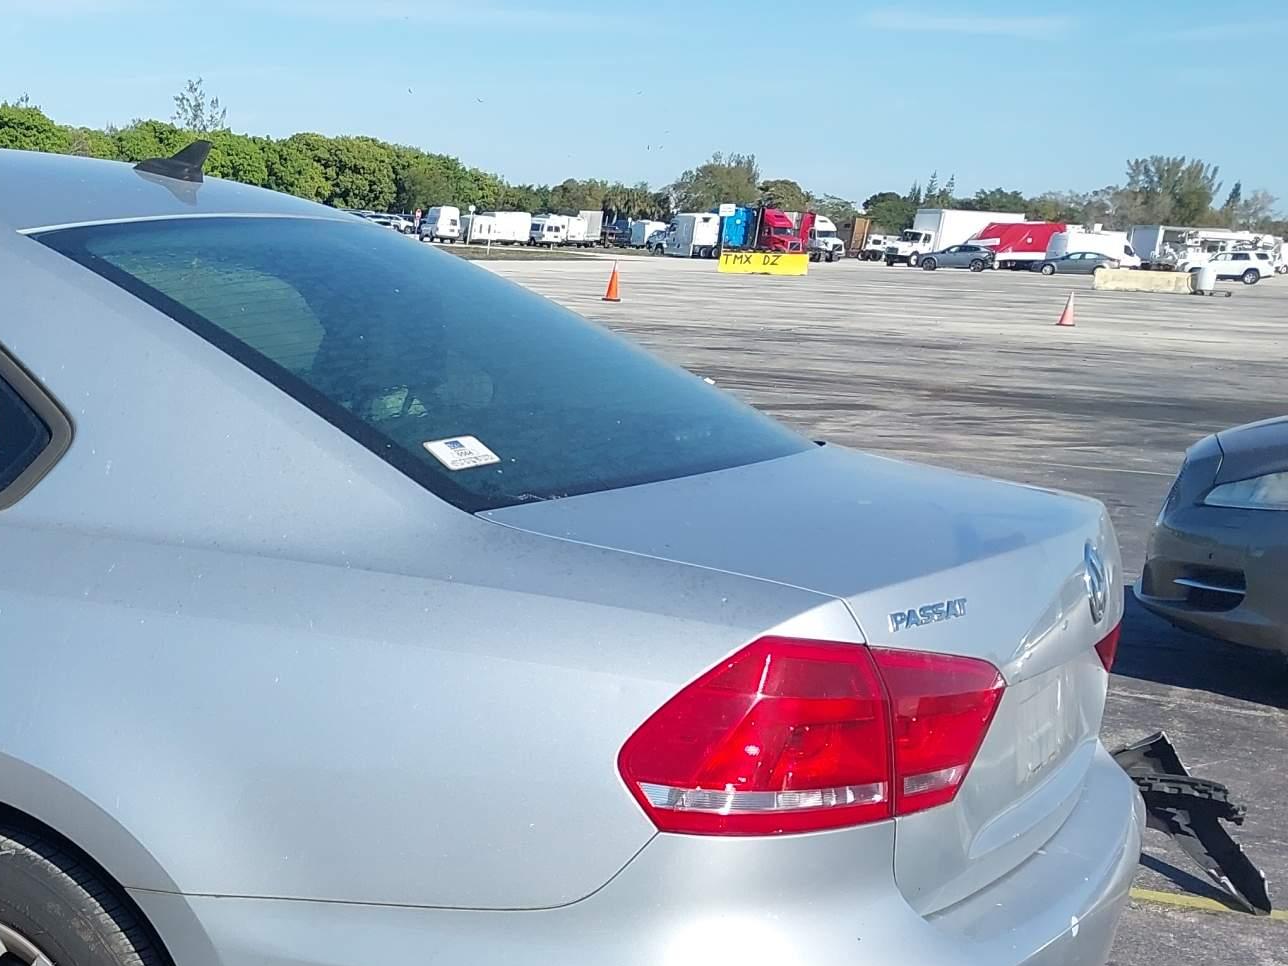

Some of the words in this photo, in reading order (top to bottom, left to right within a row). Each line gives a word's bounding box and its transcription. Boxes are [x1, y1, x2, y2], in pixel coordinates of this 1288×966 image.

[723, 253, 753, 266] TMX
[762, 254, 783, 266] DZ
[888, 597, 968, 633] PASSAT
